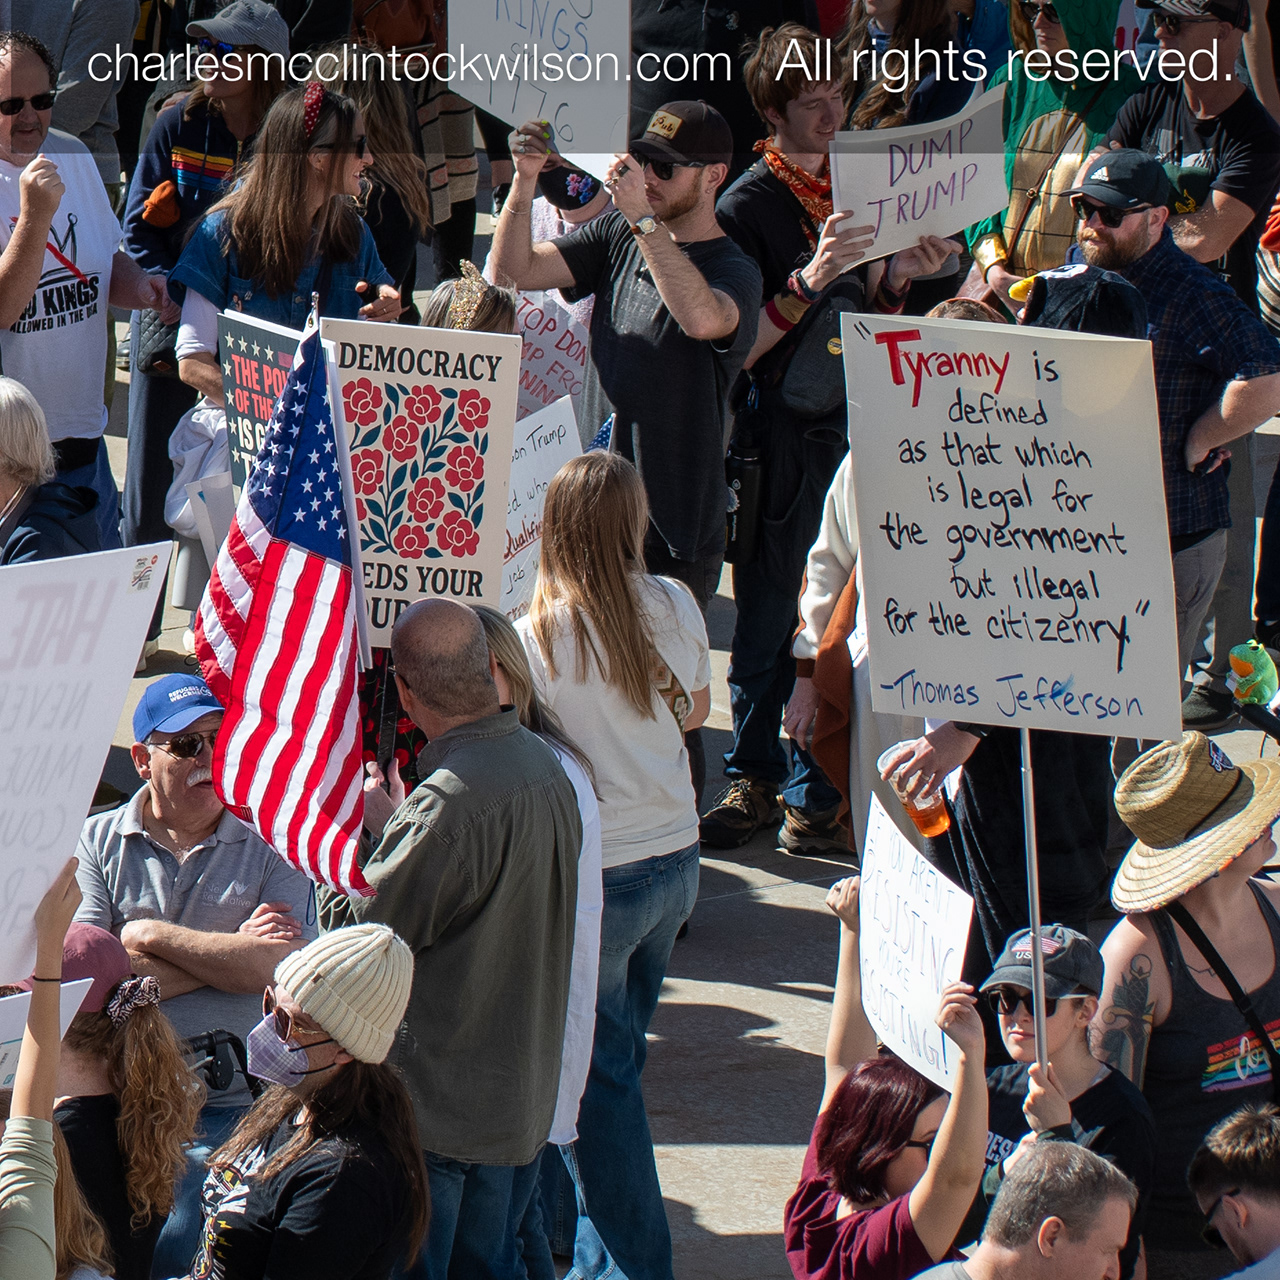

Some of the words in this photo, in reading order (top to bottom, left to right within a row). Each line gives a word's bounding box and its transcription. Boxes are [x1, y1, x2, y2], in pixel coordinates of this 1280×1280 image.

[889, 119, 973, 187] DUMP
[867, 163, 978, 239] TRUMP
[338, 341, 502, 382] DEMOCRACY
[1033, 349, 1059, 382] is
[948, 387, 1048, 426] defined
[898, 436, 927, 465] as
[941, 432, 1002, 467] that
[1015, 439, 1092, 469] which
[926, 475, 948, 504] is
[961, 470, 1034, 523] legal
[1051, 479, 1094, 514] for
[879, 511, 928, 551] the
[946, 522, 1128, 561] government
[416, 565, 483, 597] YOUR
[949, 564, 993, 601] but
[1013, 570, 1100, 618] illegal
[883, 598, 917, 636] for
[928, 601, 971, 636] the
[996, 673, 1144, 719] Jefferson
